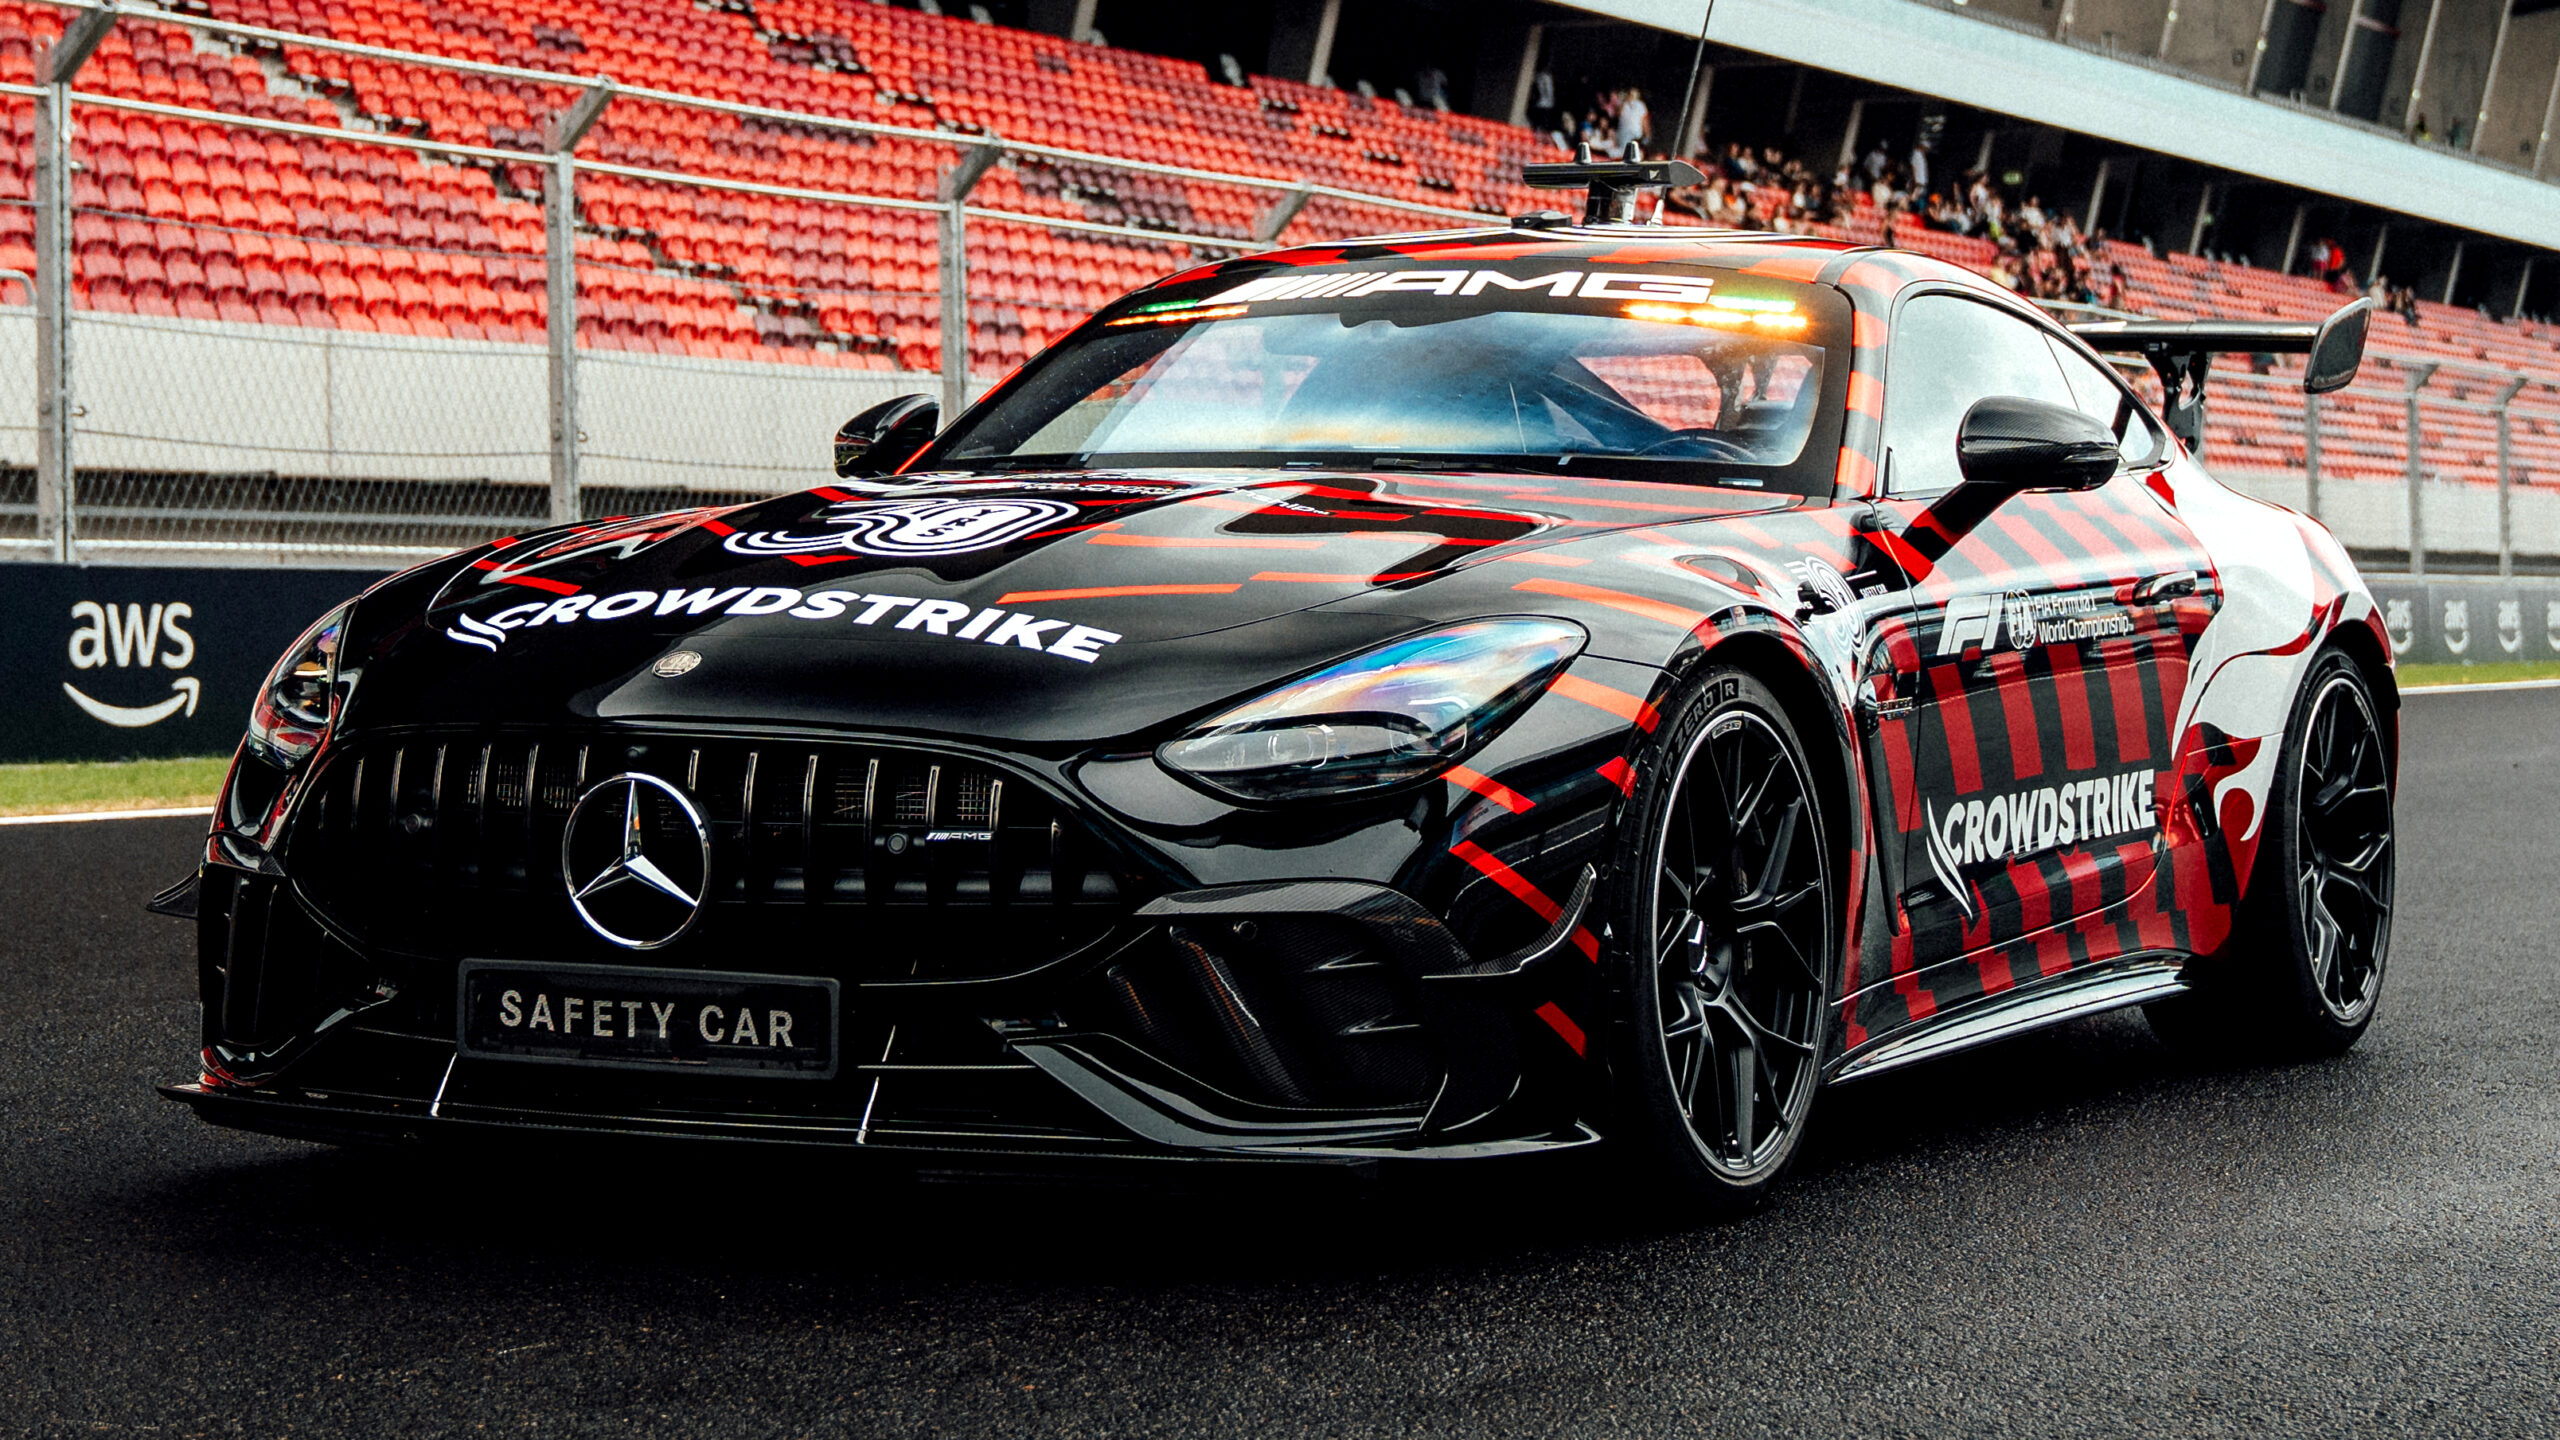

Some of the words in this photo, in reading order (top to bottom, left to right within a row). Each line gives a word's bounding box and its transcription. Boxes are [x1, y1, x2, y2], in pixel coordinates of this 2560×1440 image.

[69, 600, 195, 669] aws
[484, 585, 1123, 664] CROWDSTRIKE
[1936, 593, 2004, 656] F1
[2034, 595, 2052, 618] FIA
[2052, 592, 2092, 615] Formula
[2090, 590, 2098, 612] 1
[2038, 619, 2067, 644] World
[1665, 751, 1674, 778] P
[1675, 690, 1714, 753] ZERO
[1724, 682, 1736, 698] R
[948, 831, 992, 841] AMG
[1940, 768, 2156, 868] CROWDSTRIKE
[500, 989, 675, 1039] SAFETY
[699, 1004, 794, 1047] CAR
